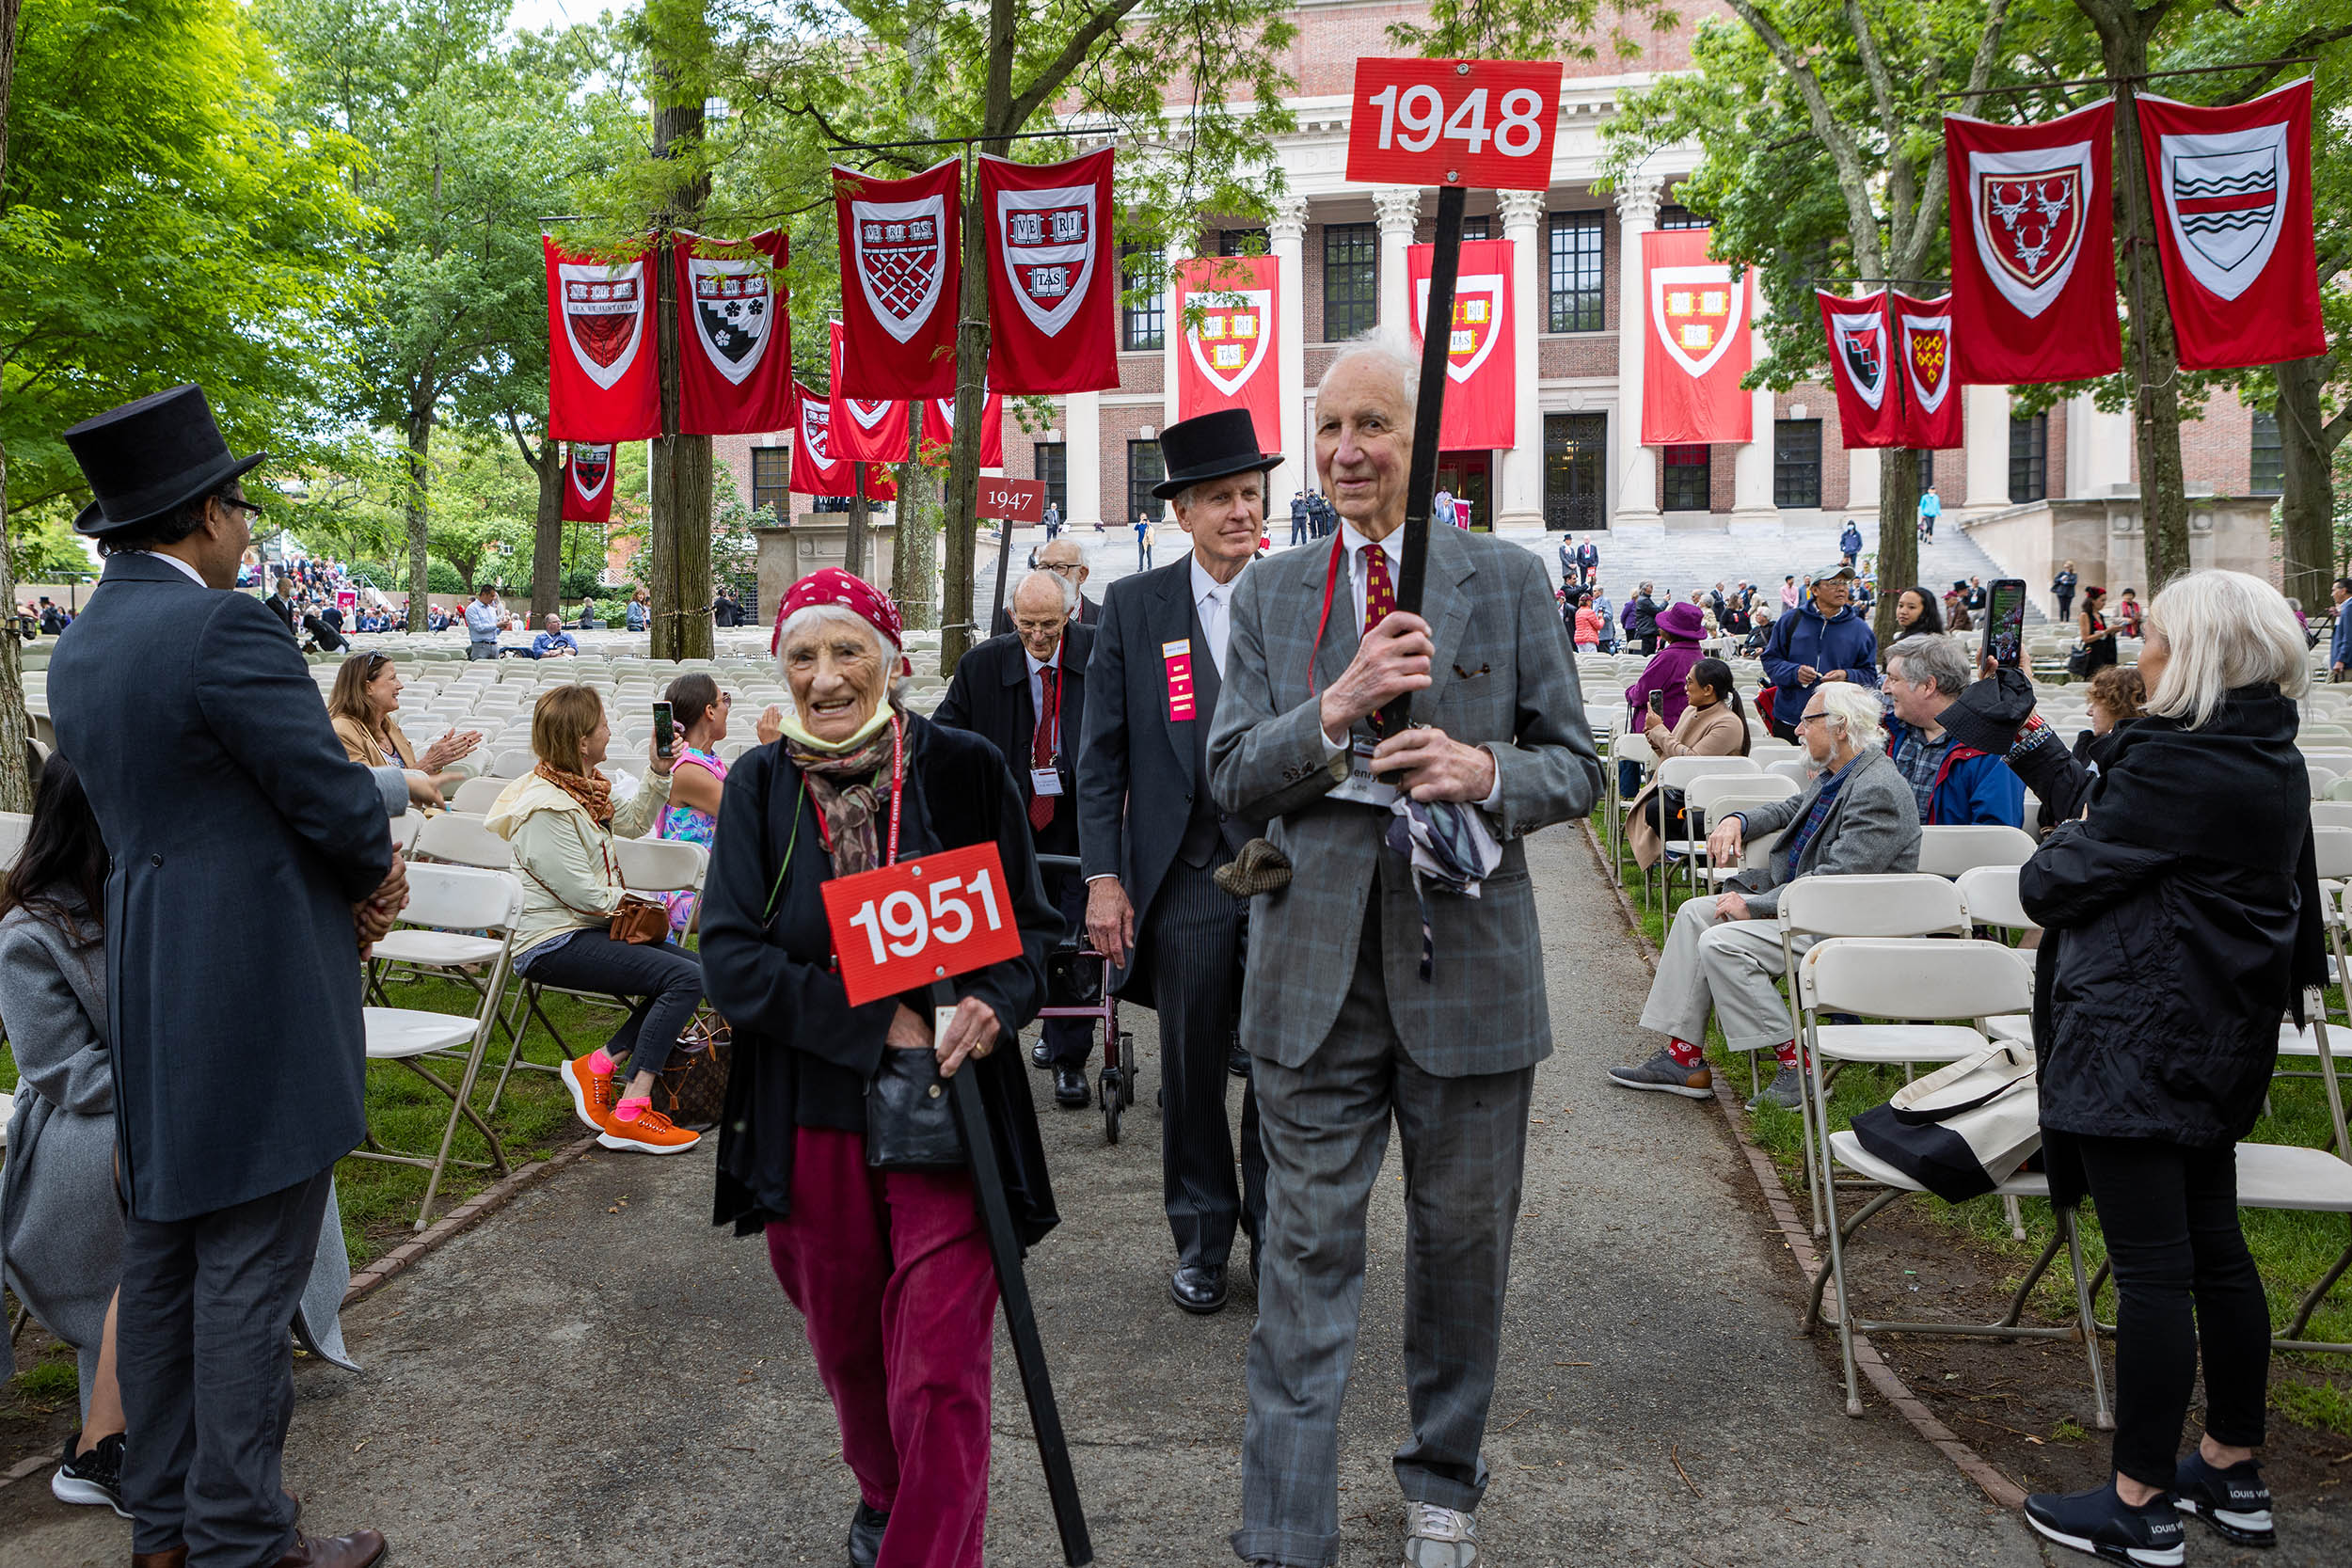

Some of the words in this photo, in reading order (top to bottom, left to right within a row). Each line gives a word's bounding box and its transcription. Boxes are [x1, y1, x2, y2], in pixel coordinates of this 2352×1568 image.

[1369, 84, 1543, 157] 1948
[914, 224, 930, 233] TAS
[1019, 219, 1036, 233] VE
[1058, 217, 1074, 231] RI
[1037, 273, 1060, 286] TAS
[1219, 349, 1238, 360] TAS
[988, 490, 1033, 511] 1947
[849, 868, 1002, 965] 1951
[2230, 1490, 2255, 1498] LOUIS
[2151, 1523, 2176, 1534] LOUIS
